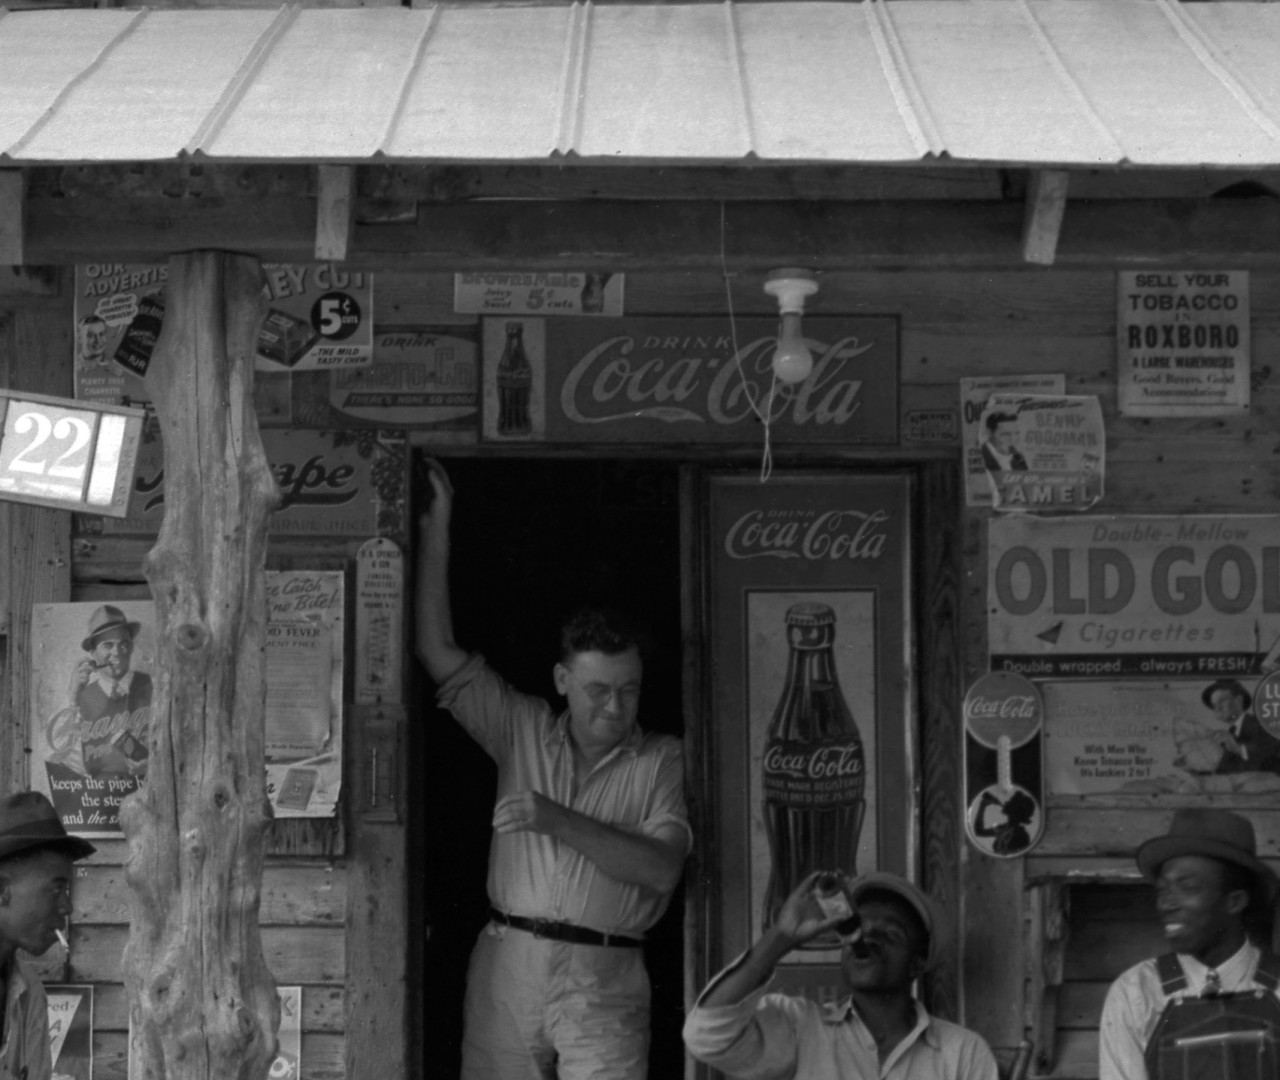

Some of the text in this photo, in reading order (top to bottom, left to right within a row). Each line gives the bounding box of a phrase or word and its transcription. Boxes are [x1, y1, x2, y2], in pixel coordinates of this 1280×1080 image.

[1135, 274, 1229, 288] SELL YOUR
[547, 301, 574, 309] cuts
[1127, 293, 1238, 311] TOBACCO
[381, 336, 439, 348] DRINK
[643, 335, 731, 350] DRINK
[1127, 323, 1239, 349] ROXBORO
[337, 347, 359, 355] MILD
[318, 355, 368, 364] TASTY CHEW
[560, 335, 875, 425] Coca-Cola
[1034, 412, 1086, 428] BENNY
[8, 411, 90, 479] 22
[1024, 430, 1097, 446] GOODMAN
[724, 509, 890, 560] Coca-Cola
[282, 577, 322, 596] Catch
[994, 545, 1136, 616] OLD
[286, 628, 320, 638] FEVER
[1078, 622, 1216, 651] Cigarettes
[1003, 660, 1053, 674] Double
[1140, 661, 1193, 675] always
[969, 696, 1035, 719] Coca-Cola
[1084, 745, 1105, 755] With
[1127, 745, 1147, 755] Who
[764, 742, 862, 779] Coca-Cola
[1073, 756, 1098, 766] Know
[1100, 756, 1133, 766] Tobacco
[1095, 767, 1127, 777] Luckies
[1137, 767, 1146, 777] to
[50, 774, 83, 793] keeps
[85, 774, 105, 790] the
[108, 775, 133, 793] pipe
[81, 792, 121, 808] the ste
[62, 809, 84, 825] and
[87, 810, 107, 825] the
